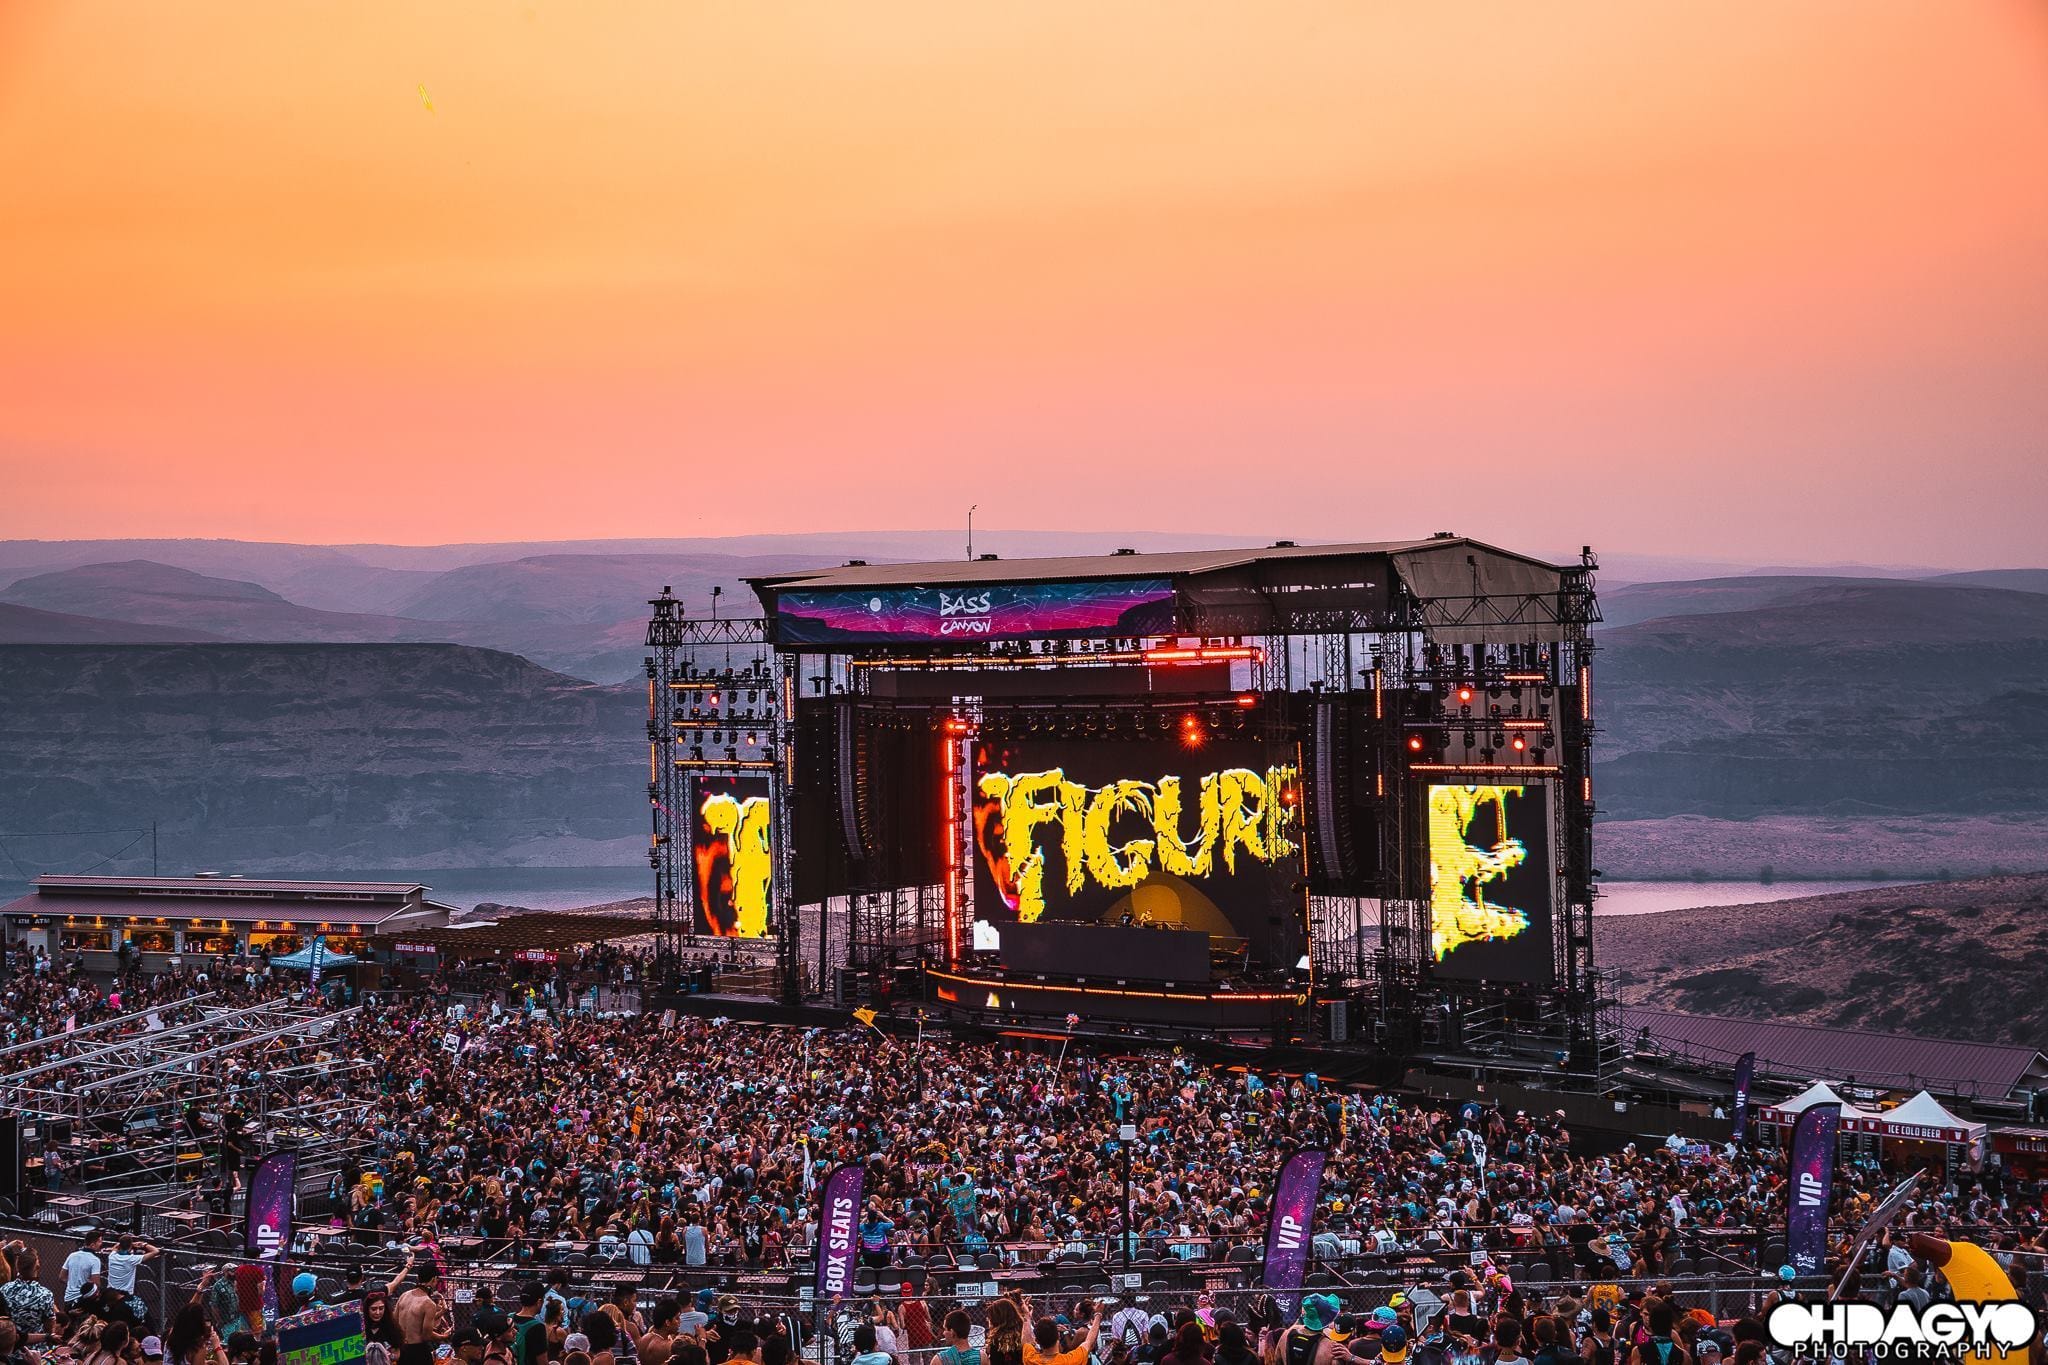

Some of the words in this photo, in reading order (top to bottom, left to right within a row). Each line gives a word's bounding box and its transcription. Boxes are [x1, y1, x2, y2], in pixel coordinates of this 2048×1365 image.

[939, 592, 991, 616] BASS
[940, 619, 992, 635] CANYON
[314, 942, 323, 965] WATER
[313, 967, 321, 982] FREE
[1736, 1090, 1746, 1108] VIP
[1784, 1114, 1796, 1123] ICE
[1888, 1124, 1900, 1135] ICE
[1901, 1126, 1920, 1137] COLD
[1921, 1128, 1941, 1139] BEER
[2016, 1141, 2030, 1151] ICE
[1798, 1172, 1823, 1206] VIP
[829, 1197, 853, 1251] SEATS
[1277, 1215, 1303, 1249] VIP
[256, 1224, 280, 1259] VIP
[825, 1254, 847, 1292] BOX
